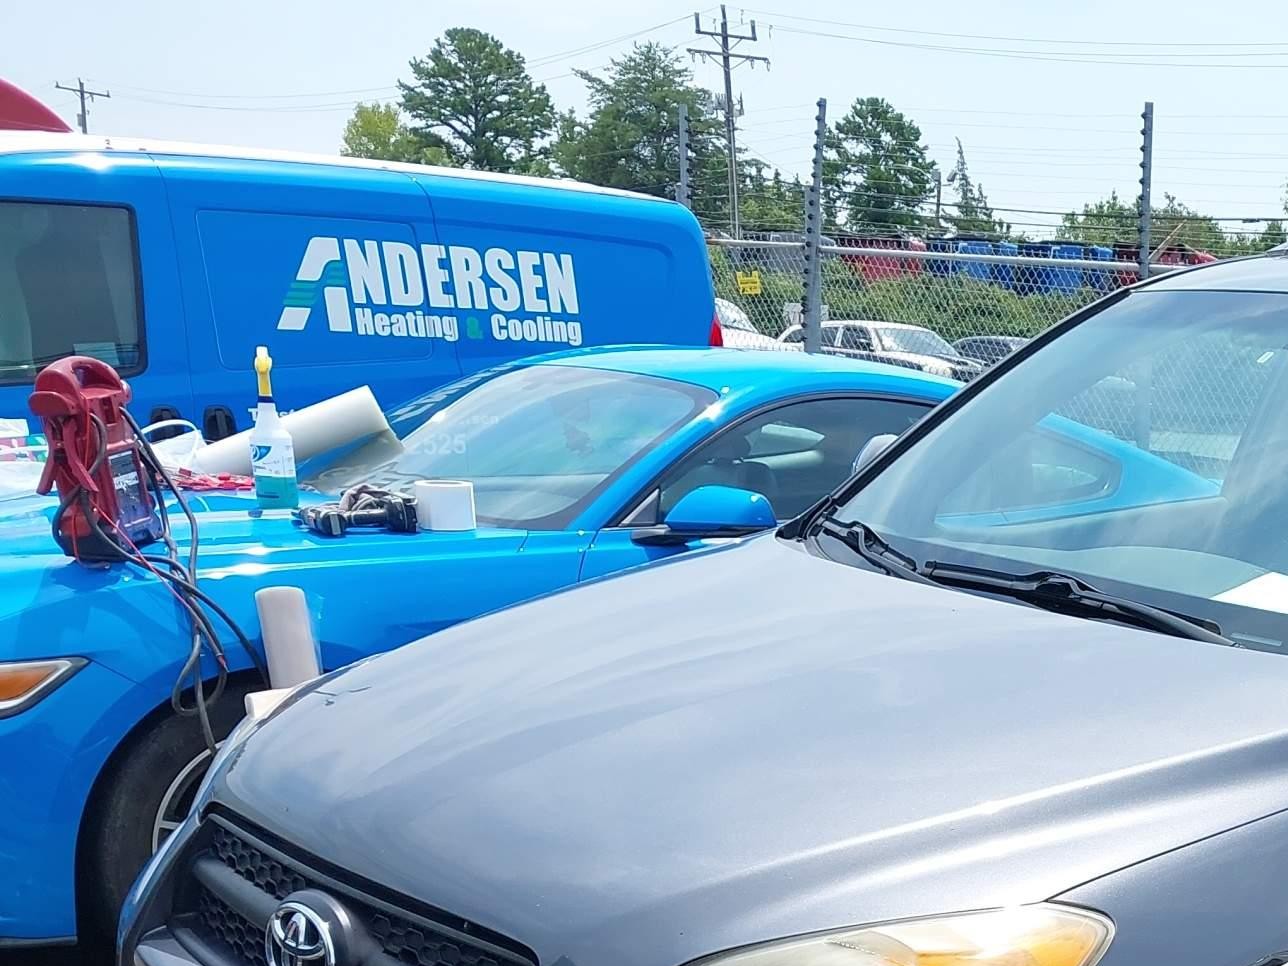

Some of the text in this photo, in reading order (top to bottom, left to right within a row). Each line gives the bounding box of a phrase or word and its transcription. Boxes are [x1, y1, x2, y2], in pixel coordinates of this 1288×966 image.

[277, 237, 579, 332] ANDERSEN
[355, 307, 582, 346] Heating & Cooling
